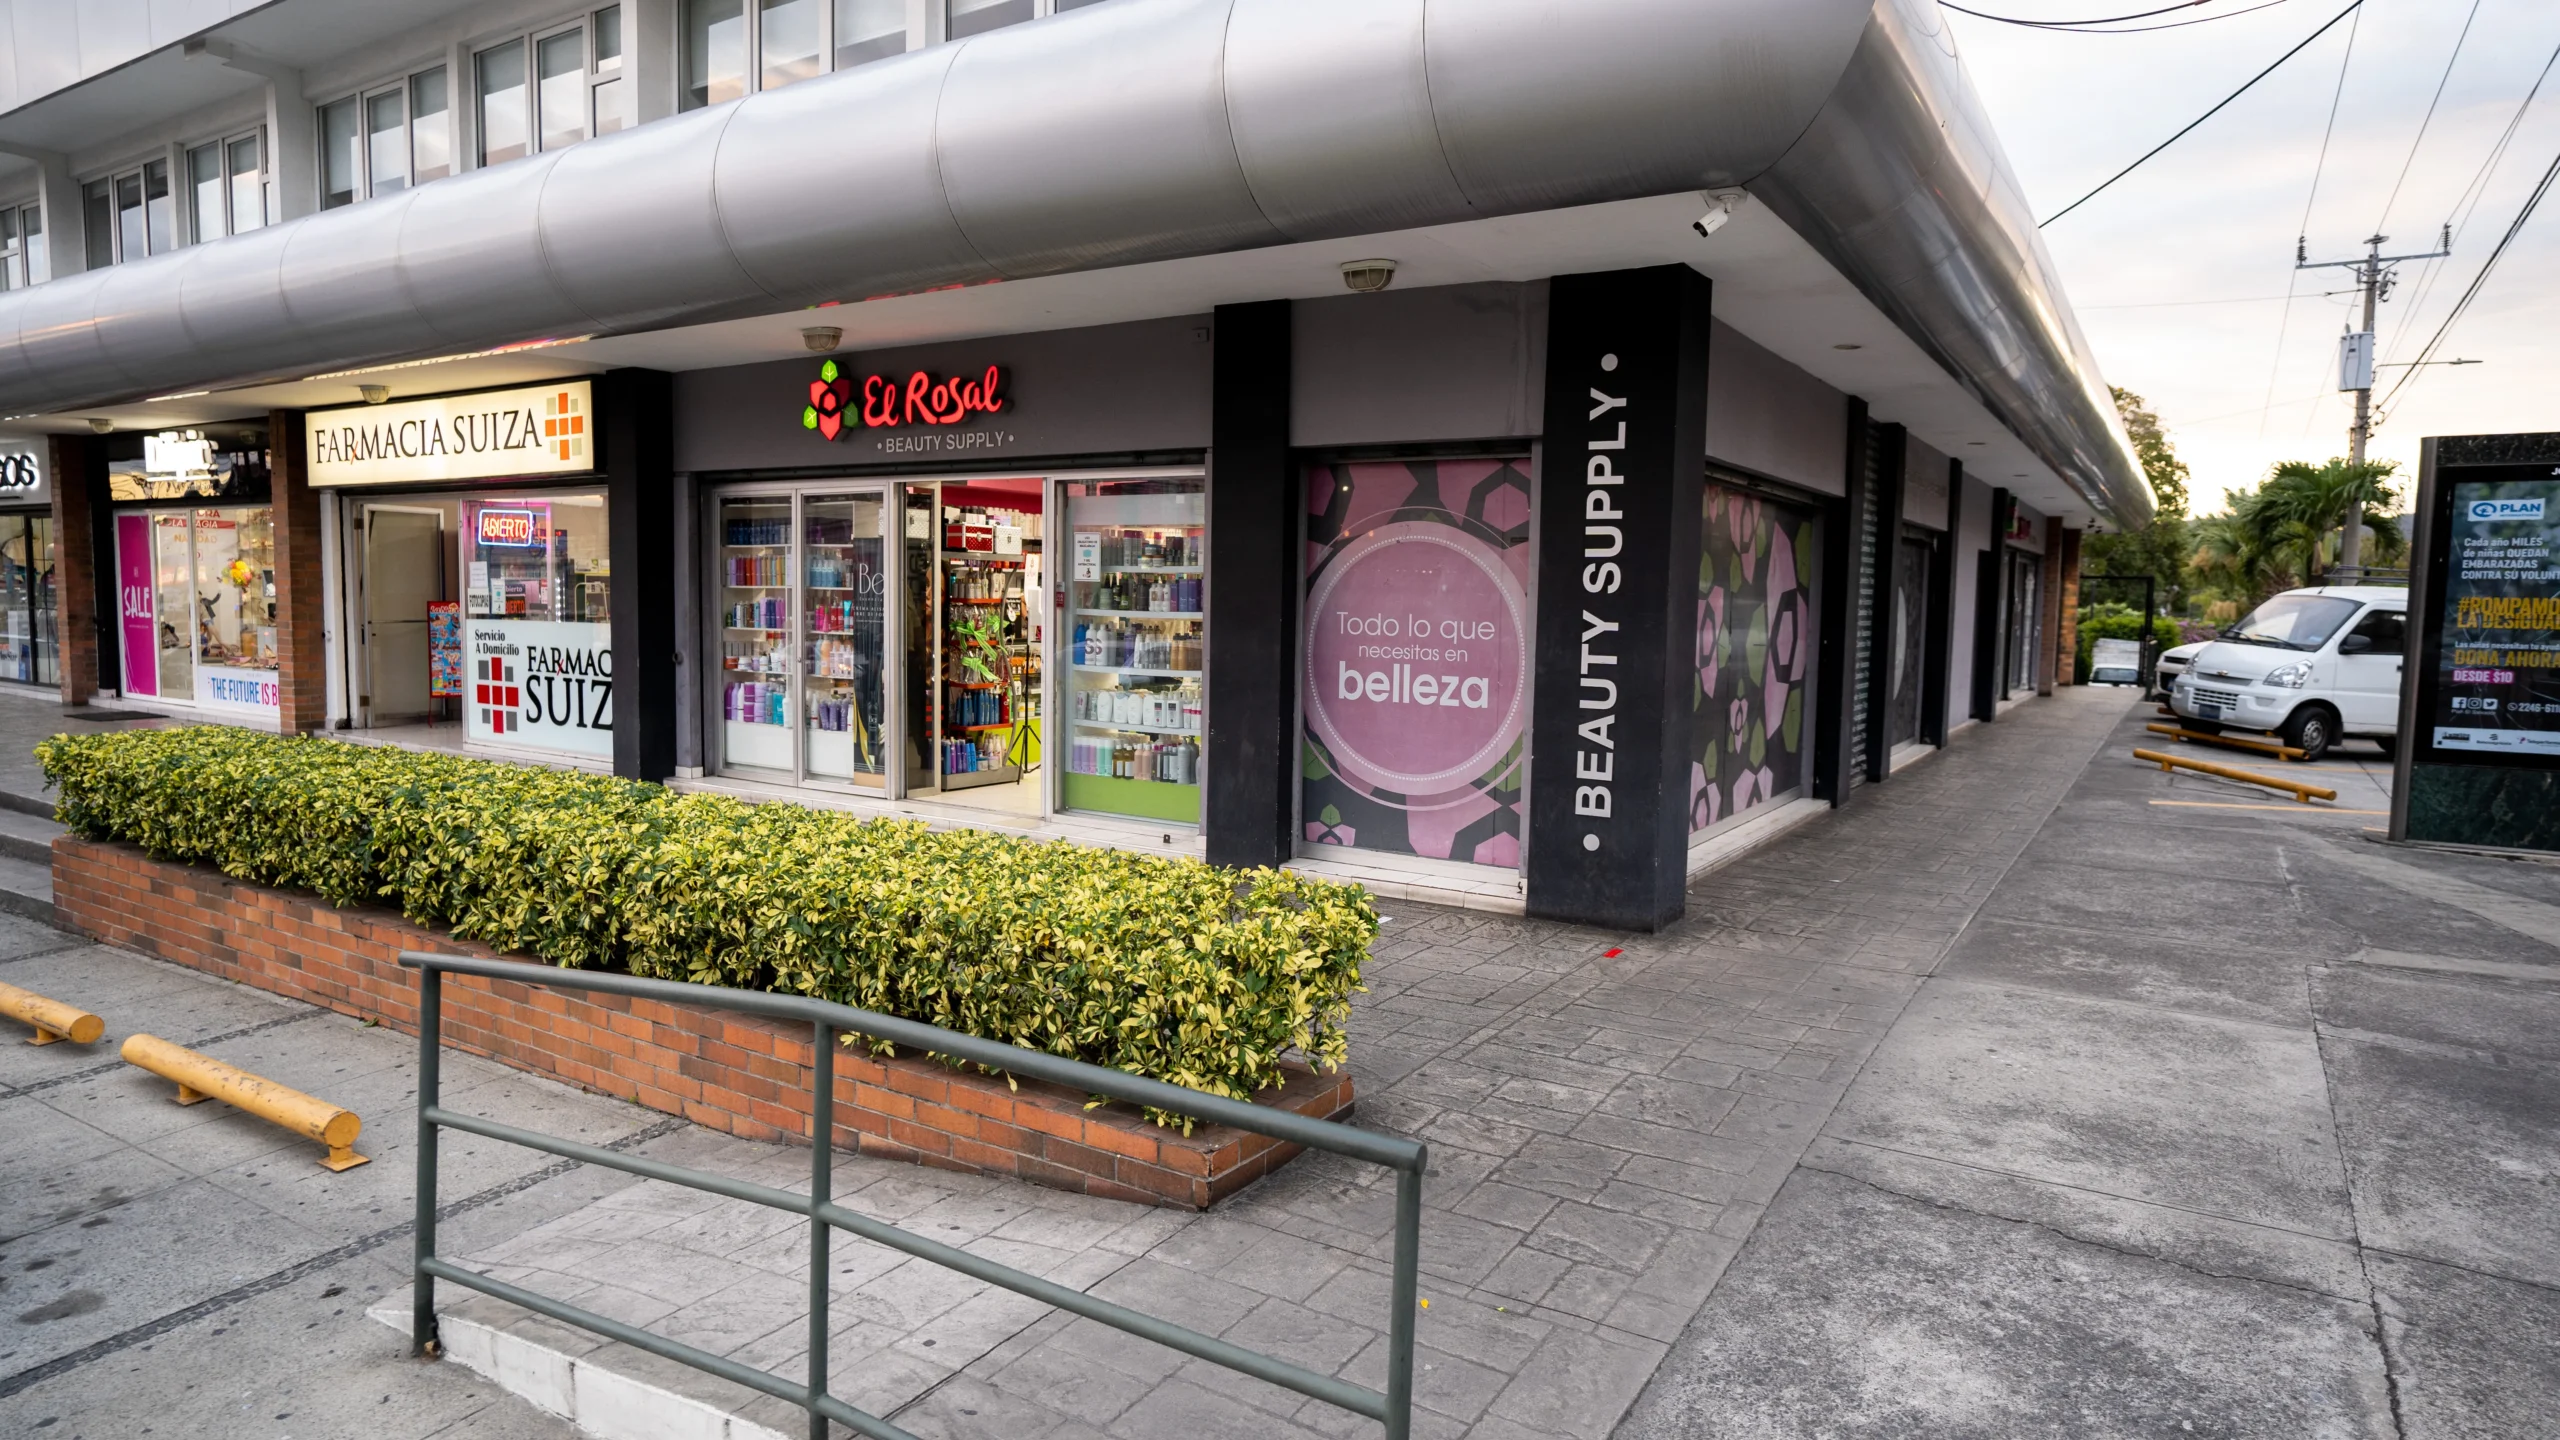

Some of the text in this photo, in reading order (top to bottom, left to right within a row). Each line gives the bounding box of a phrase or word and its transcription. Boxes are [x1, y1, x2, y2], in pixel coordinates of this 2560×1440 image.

[864, 365, 1002, 427] El Rosal
[315, 408, 543, 465] FARMACIA SUIZA
[886, 431, 1004, 453] BEAUTY SUPPLY
[0, 454, 36, 487] OS
[2500, 503, 2541, 513] PLAN
[195, 520, 218, 529] AGIA
[482, 517, 529, 539] ABIERTO
[2464, 538, 2543, 547] Cada año MILES
[2463, 549, 2549, 558] de niñas QUEDAN
[2462, 560, 2538, 569] EMBARAZADAS
[2461, 570, 2501, 580] CONTRA
[2504, 571, 2518, 580] SU
[124, 585, 152, 619] SALE
[1574, 387, 1627, 818] BEAUTY SUPPLY
[474, 629, 506, 642] Servicio
[1336, 611, 1495, 645] Todo lo que
[475, 643, 519, 656] A Domicilio
[1358, 644, 1468, 662] necesitas en
[2455, 641, 2469, 649] Las
[526, 645, 612, 678] FARMAC
[2455, 650, 2560, 668] DONA AHORA
[1338, 660, 1489, 709] belleza
[2453, 670, 2513, 683] DESDE $10
[211, 676, 280, 706] THE FUTURE IS B
[526, 674, 613, 731] SUIZ
